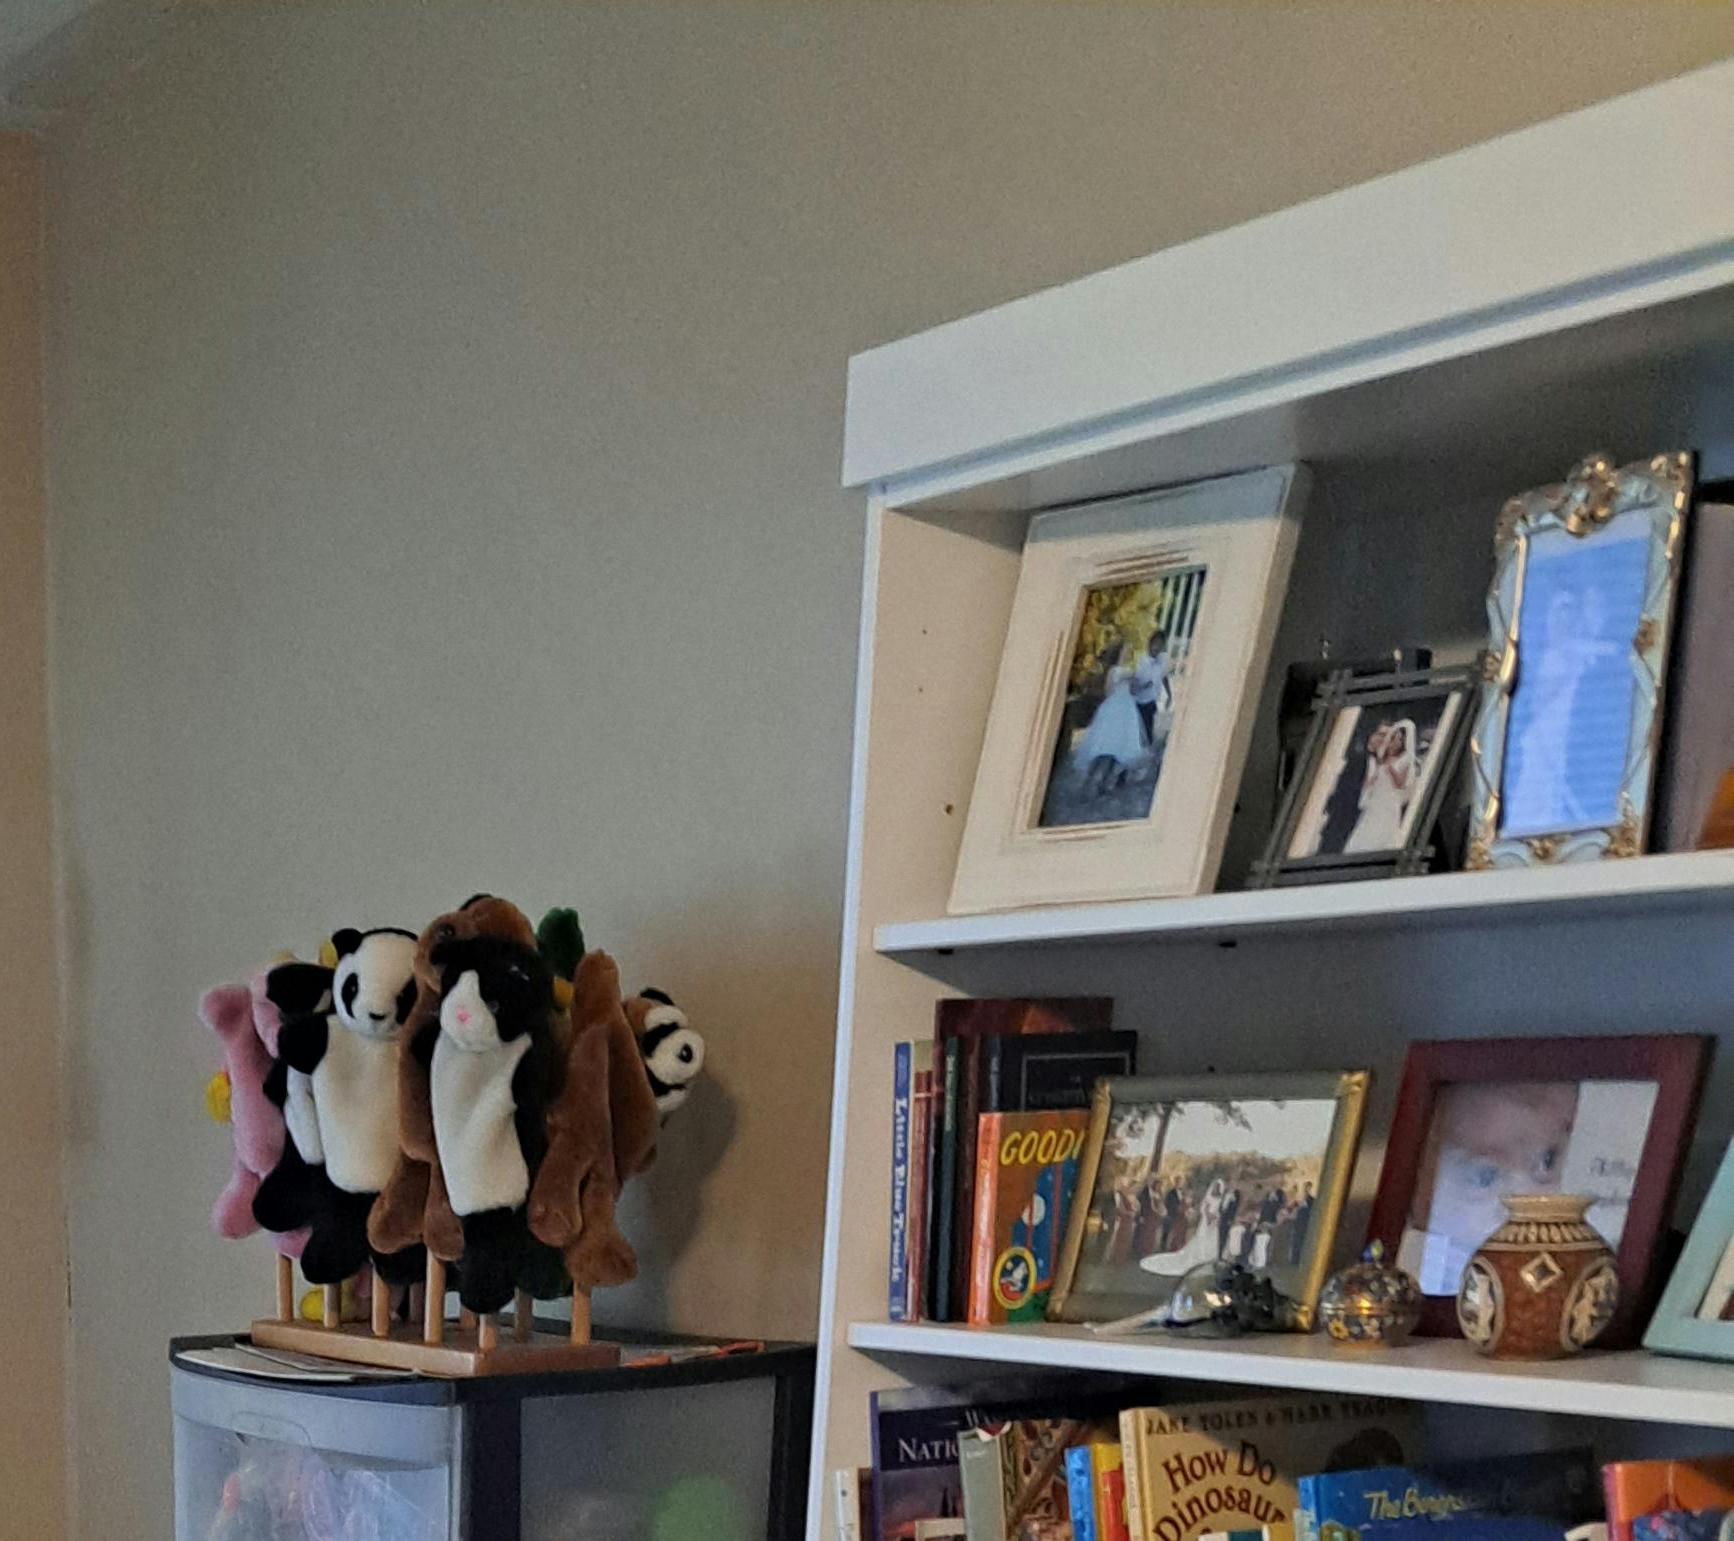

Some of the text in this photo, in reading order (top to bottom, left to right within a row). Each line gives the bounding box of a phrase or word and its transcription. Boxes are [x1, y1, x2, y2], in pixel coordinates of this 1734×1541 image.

[894, 1098, 908, 1160] Little
[1162, 1440, 1278, 1495] How Do
[1364, 1489, 1401, 1520] The
